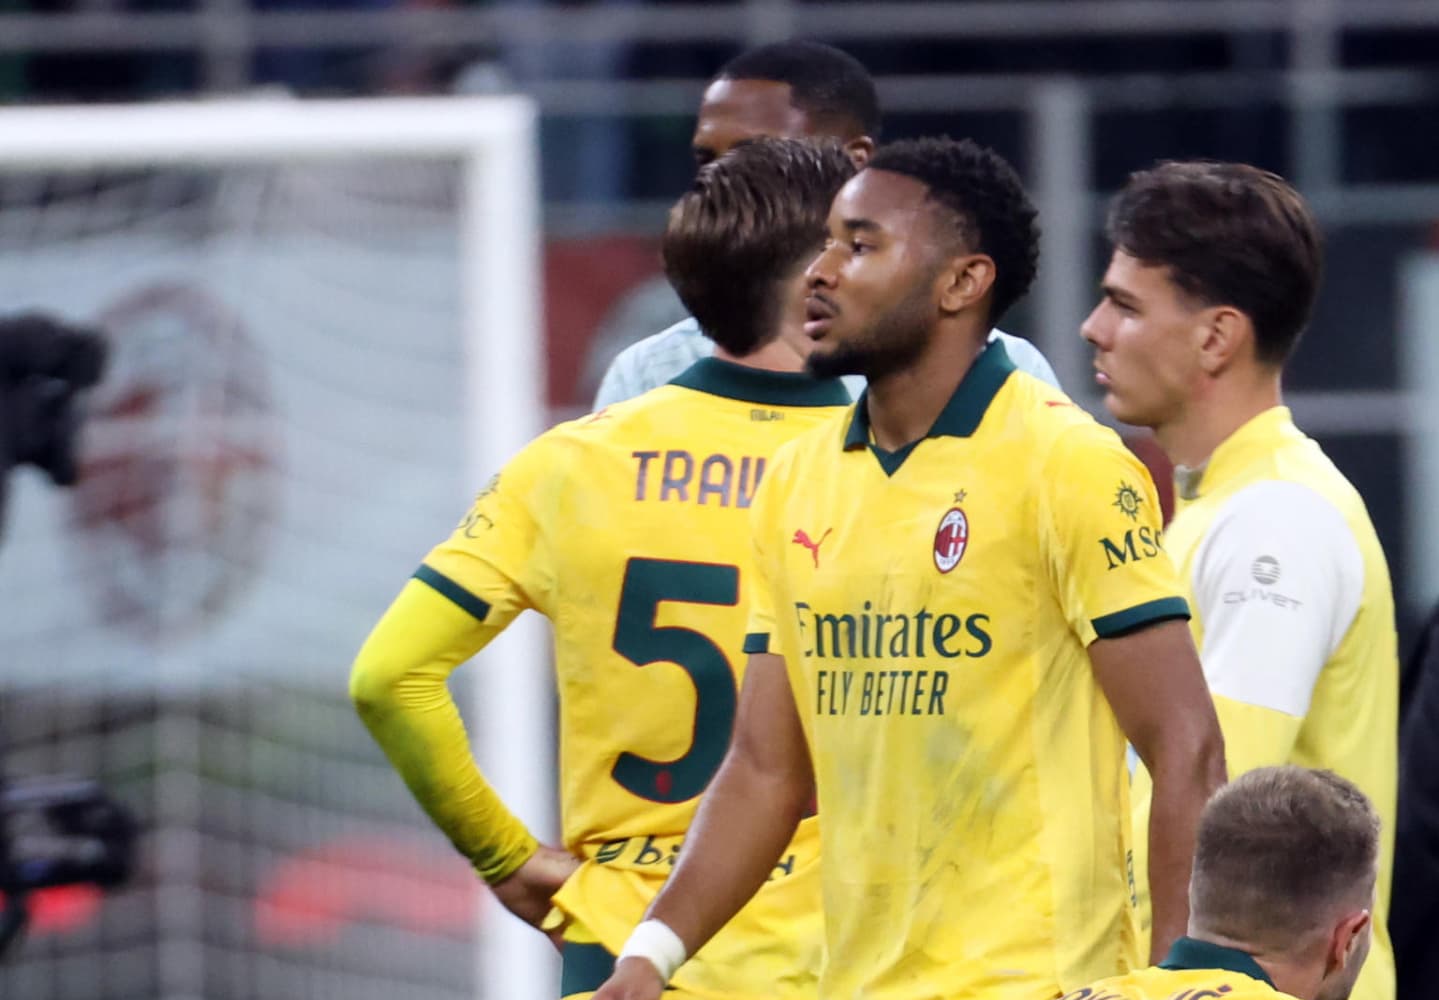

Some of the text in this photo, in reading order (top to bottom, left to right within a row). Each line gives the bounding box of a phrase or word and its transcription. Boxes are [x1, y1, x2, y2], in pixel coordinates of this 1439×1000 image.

[795, 600, 993, 659] Emirates
[610, 556, 739, 805] 5
[816, 670, 950, 716] FLY BETTER
